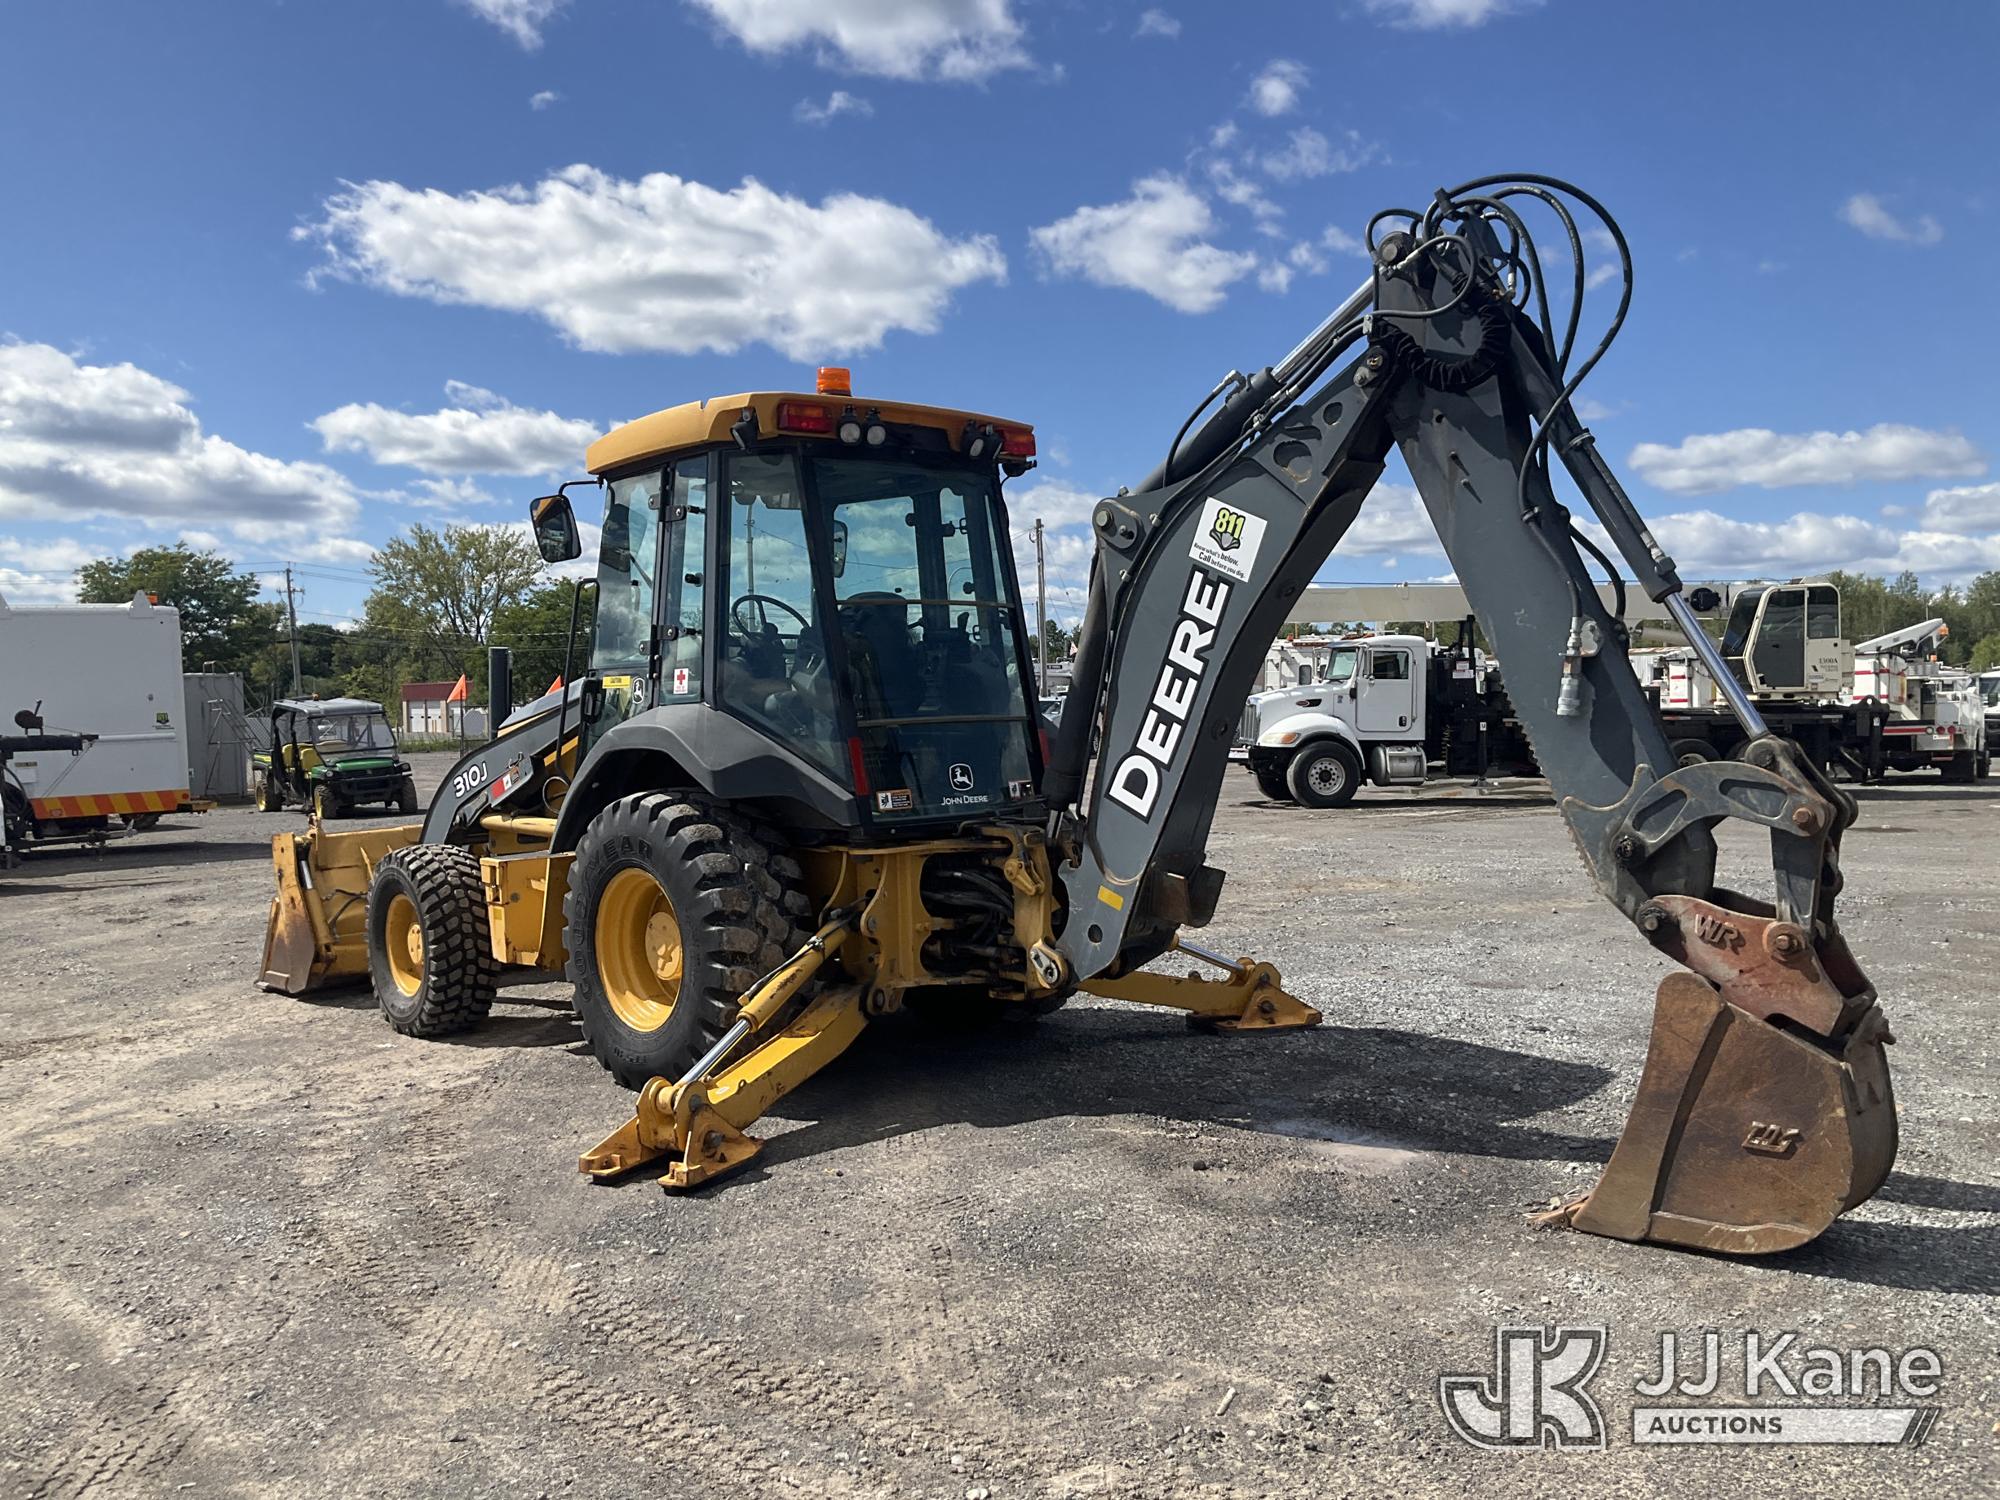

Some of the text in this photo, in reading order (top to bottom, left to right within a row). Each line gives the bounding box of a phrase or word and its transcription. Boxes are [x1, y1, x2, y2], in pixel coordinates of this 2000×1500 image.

[1214, 508, 1245, 540] 811
[1199, 552, 1212, 562] Call
[1211, 559, 1227, 571] before
[1221, 553, 1239, 566] below.
[1108, 568, 1231, 819] DEERE
[453, 762, 488, 798] 310J
[940, 795, 989, 806] JOHN DEERE
